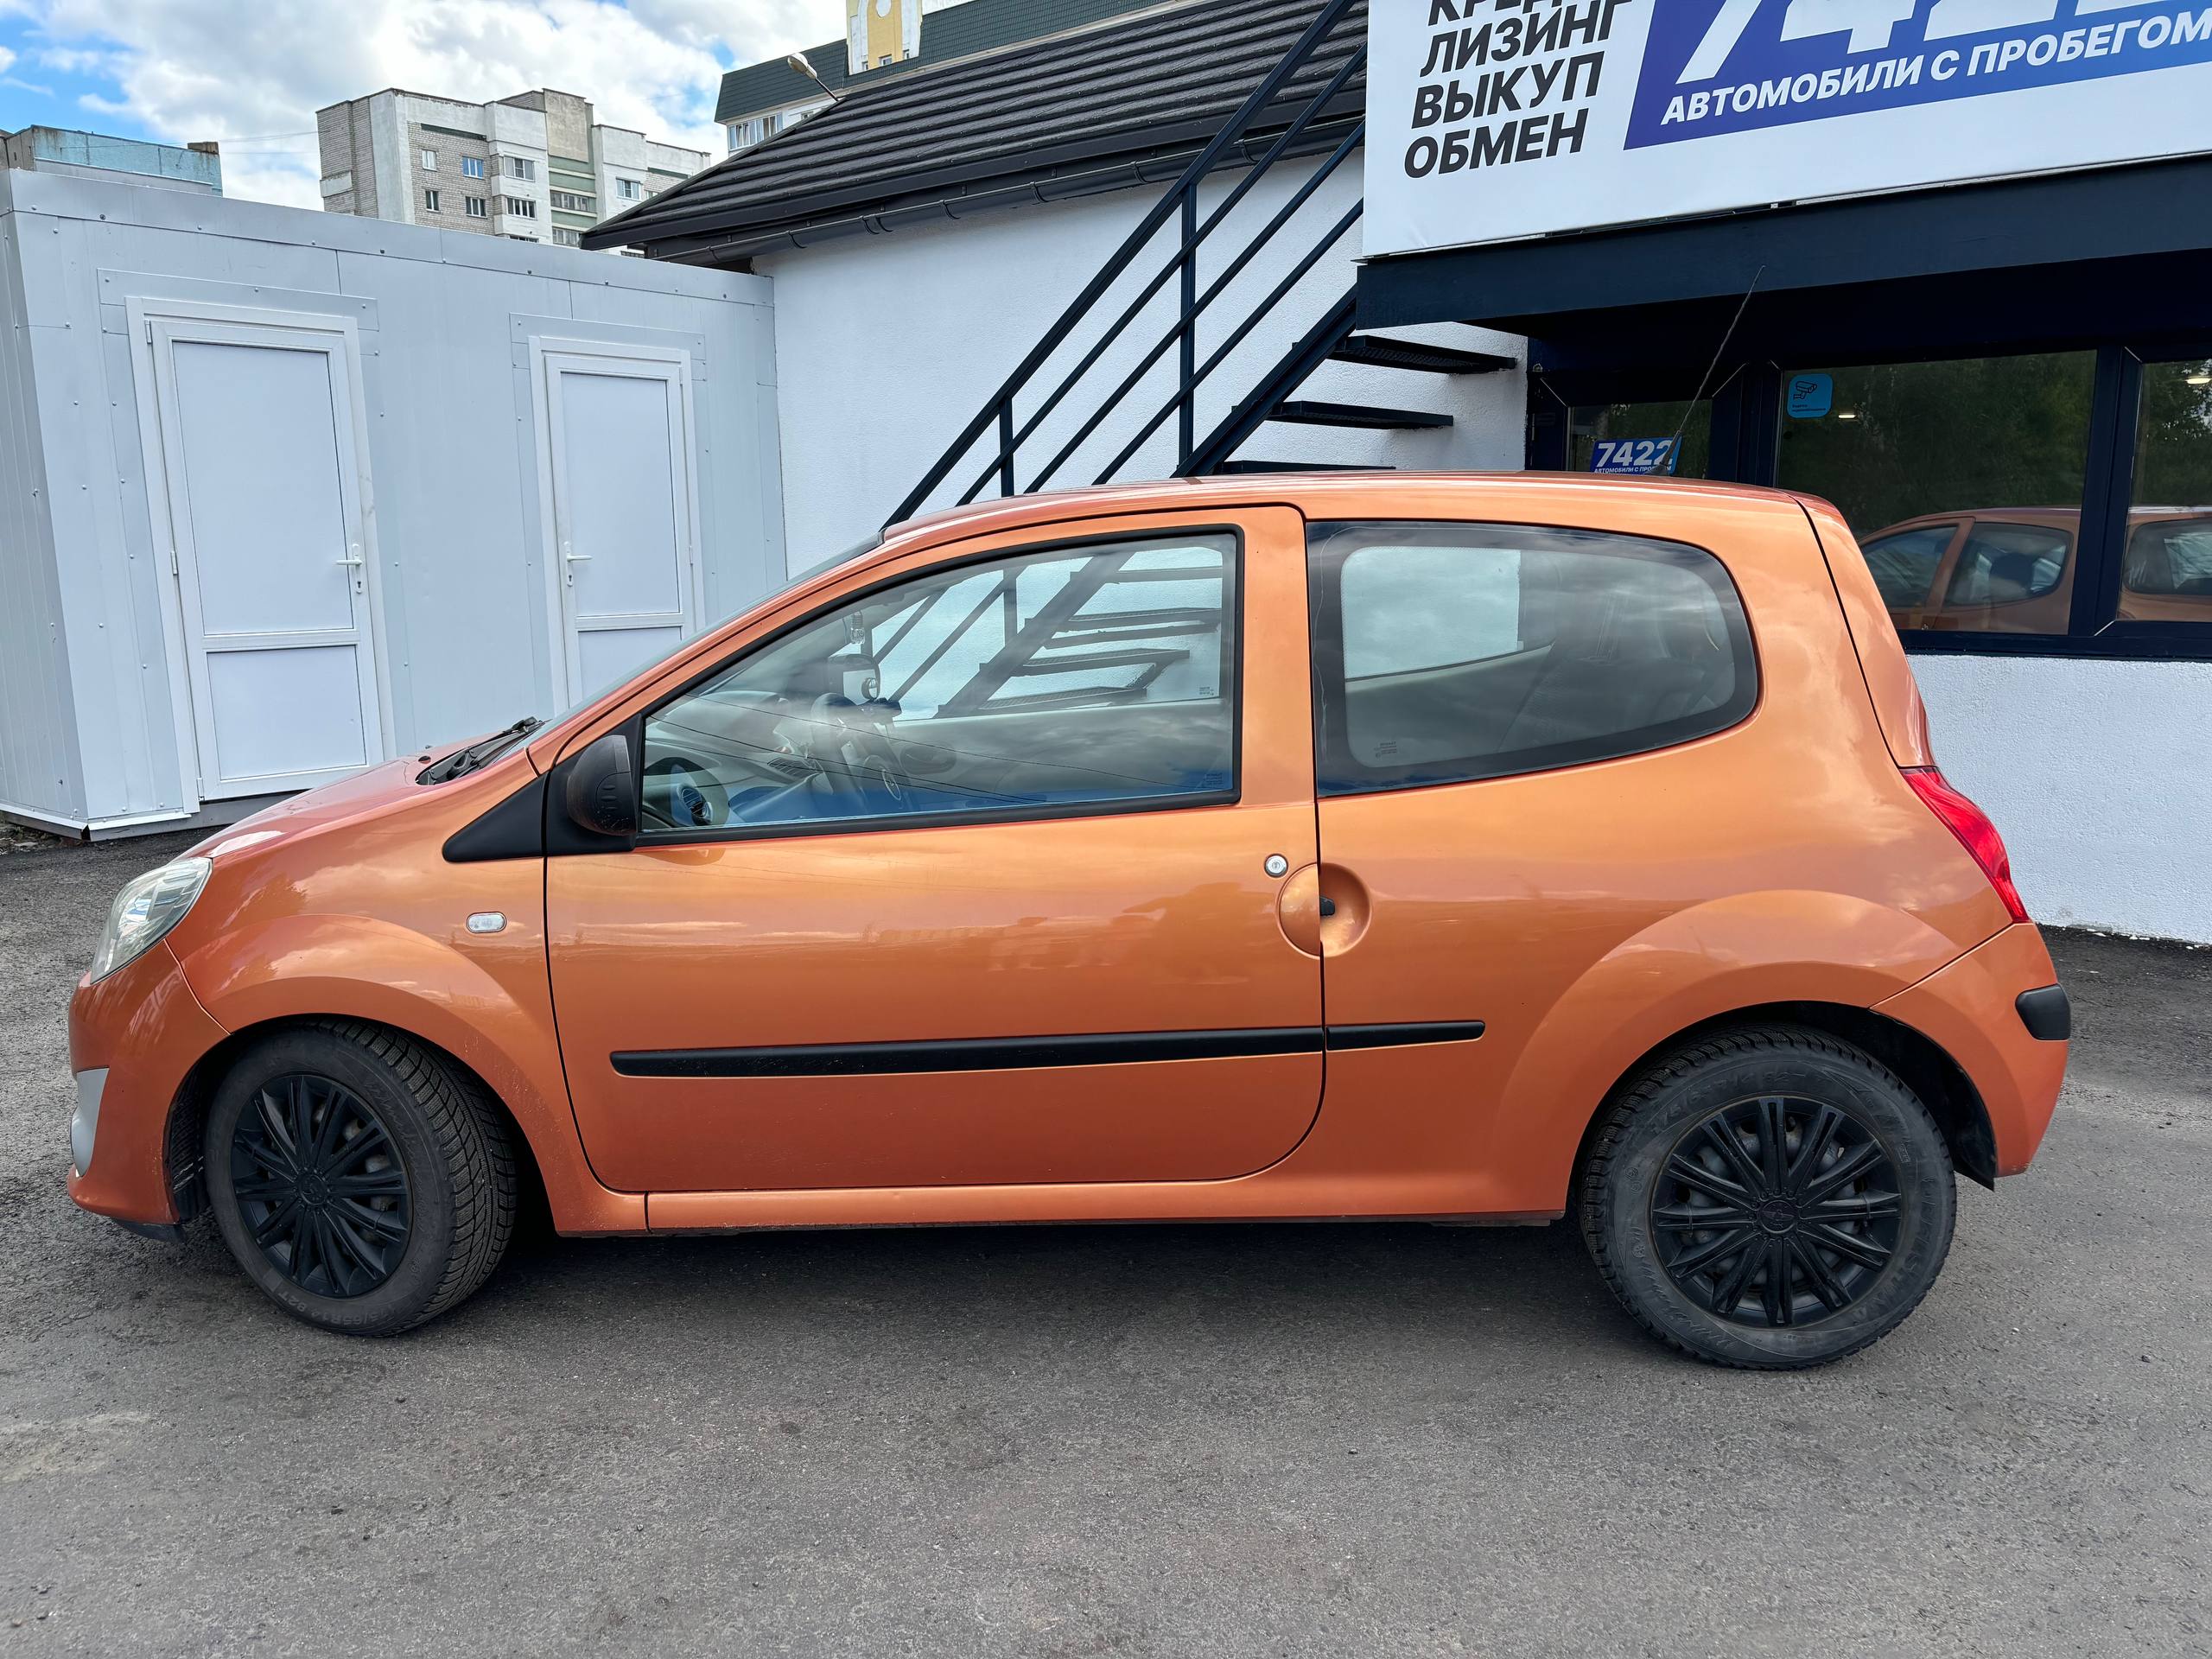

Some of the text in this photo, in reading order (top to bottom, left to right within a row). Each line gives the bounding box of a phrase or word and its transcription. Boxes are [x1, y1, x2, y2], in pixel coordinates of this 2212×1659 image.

[1420, 0, 1632, 77] ЛИЗИНГ
[1660, 54, 1924, 125] АВТОМОБИЛИ
[1930, 49, 1960, 81] С
[1967, 7, 2212, 76] ПРОБЕГОМ
[1411, 51, 1605, 129] ВЫКУП
[1404, 108, 1589, 178] ОБМЕН
[1596, 440, 1673, 467] 7422
